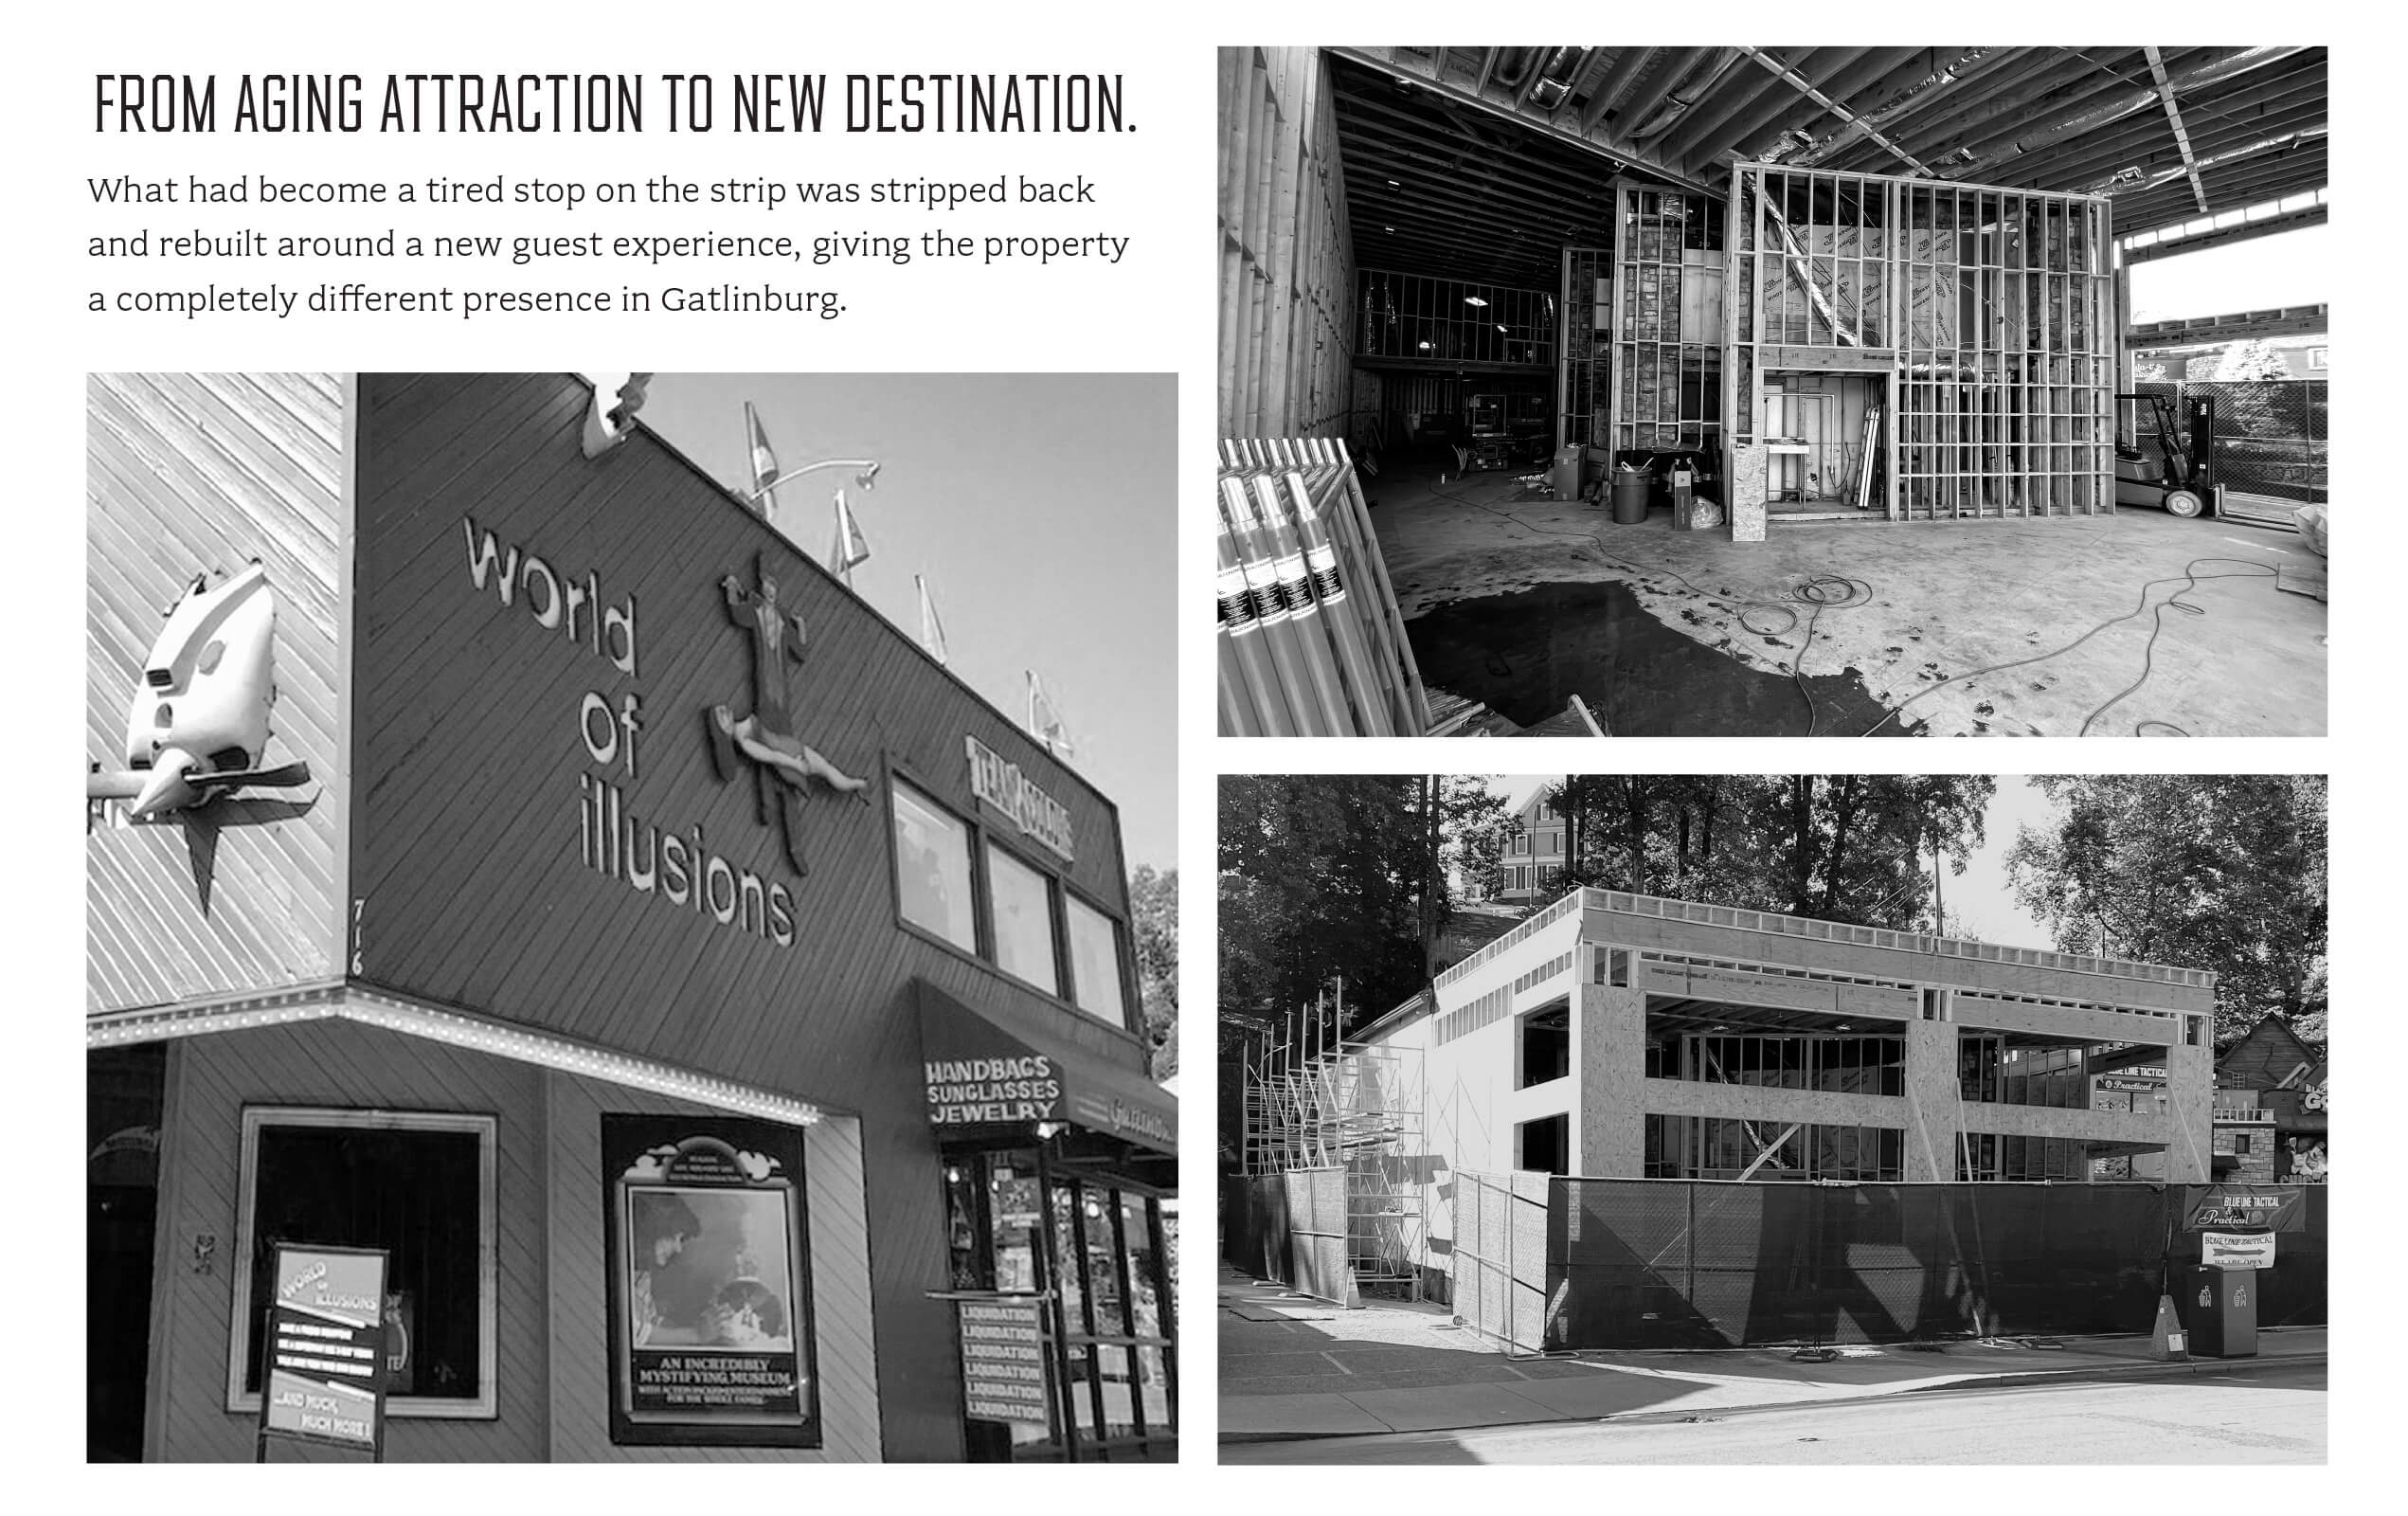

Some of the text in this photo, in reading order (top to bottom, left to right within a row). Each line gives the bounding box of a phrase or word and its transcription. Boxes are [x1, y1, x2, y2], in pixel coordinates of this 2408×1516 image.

[464, 516, 638, 679] world
[580, 690, 644, 779] of
[580, 771, 798, 948] illusions
[925, 1056, 1051, 1084] HANDBAGS
[927, 1079, 1060, 1105] SUNGLASSES
[930, 1101, 1056, 1124] JEWELRY
[2223, 1196, 2280, 1207] BLUE LINE TACTICAL
[2198, 1209, 2250, 1226] Practical
[961, 1305, 1036, 1322] LIQUIDATION
[962, 1323, 1038, 1342] LIQUIDATION
[964, 1342, 1039, 1361] LIQUIDATION
[966, 1362, 1041, 1381] LIQUIDATION
[967, 1381, 1043, 1400] LIQUIDATION
[969, 1400, 1045, 1419] LIQUIDATION
